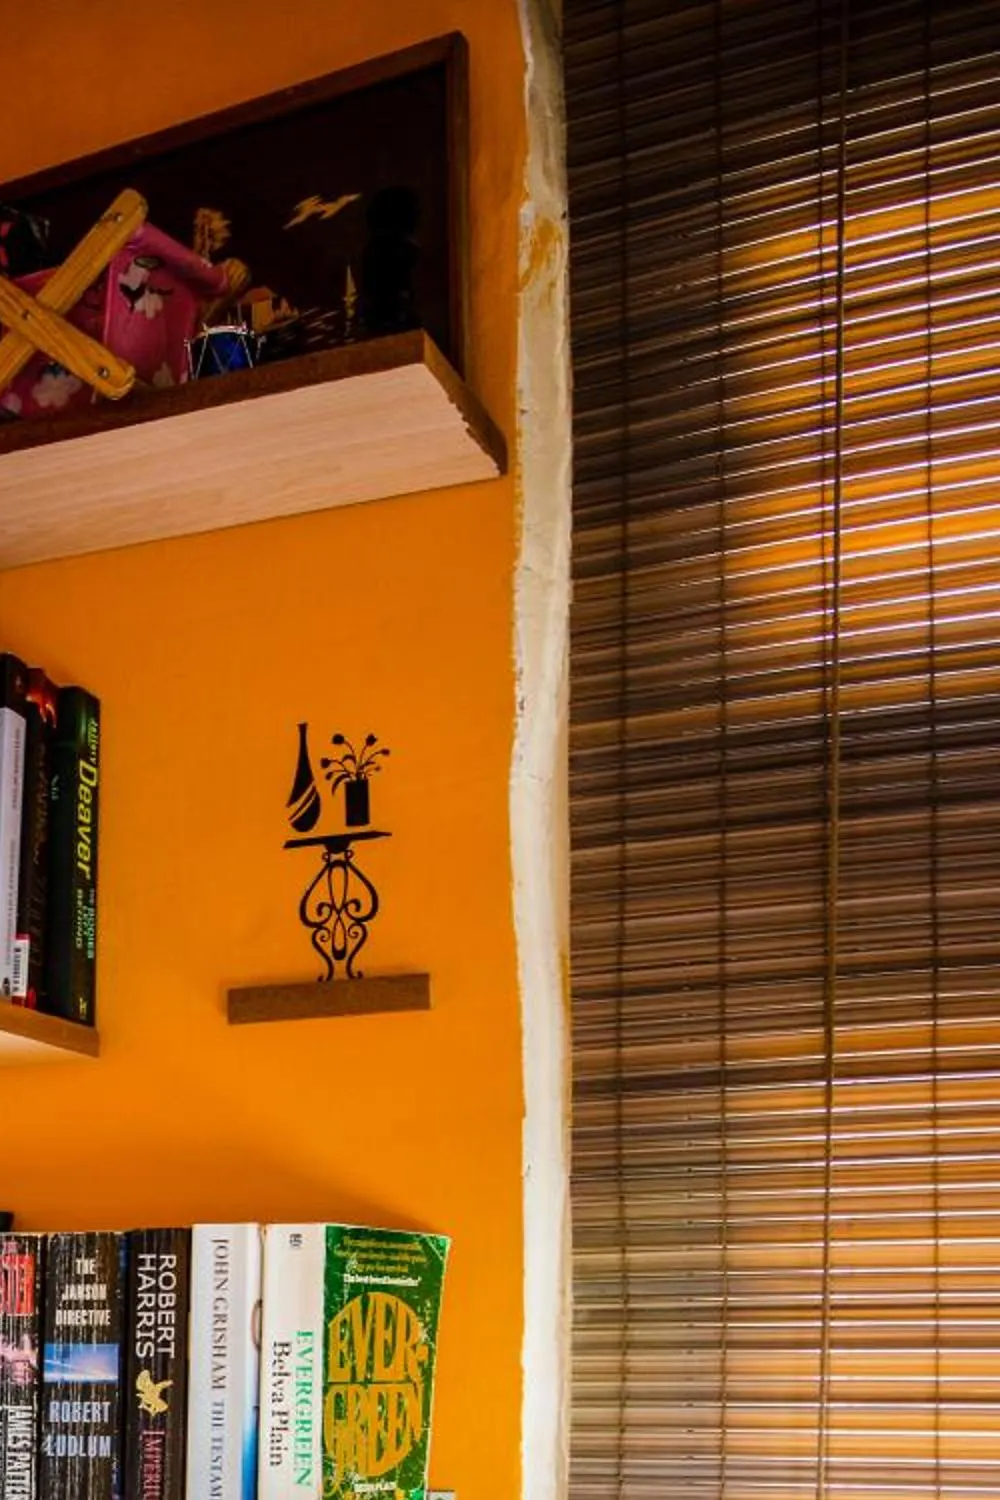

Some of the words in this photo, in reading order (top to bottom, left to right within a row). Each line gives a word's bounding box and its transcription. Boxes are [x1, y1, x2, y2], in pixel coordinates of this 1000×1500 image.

[76, 759, 98, 880] Deaver
[61, 1284, 108, 1301] JANSON
[75, 1258, 97, 1275] THE
[210, 1238, 230, 1292] JOHN
[55, 1308, 112, 1328] DIRECTIVE
[136, 1253, 156, 1360] HARRIS
[156, 1253, 178, 1360] ROBERT
[210, 1296, 229, 1391] GRISHAM
[272, 1340, 292, 1403] Belva
[4, 1405, 34, 1449] JAMES
[48, 1401, 111, 1423] ROBERT
[210, 1401, 227, 1432] THE
[291, 1329, 315, 1488] EVERGREEN
[324, 1383, 422, 1477] GREEN
[44, 1435, 112, 1458] LUDLUM
[269, 1410, 291, 1468] Plain
